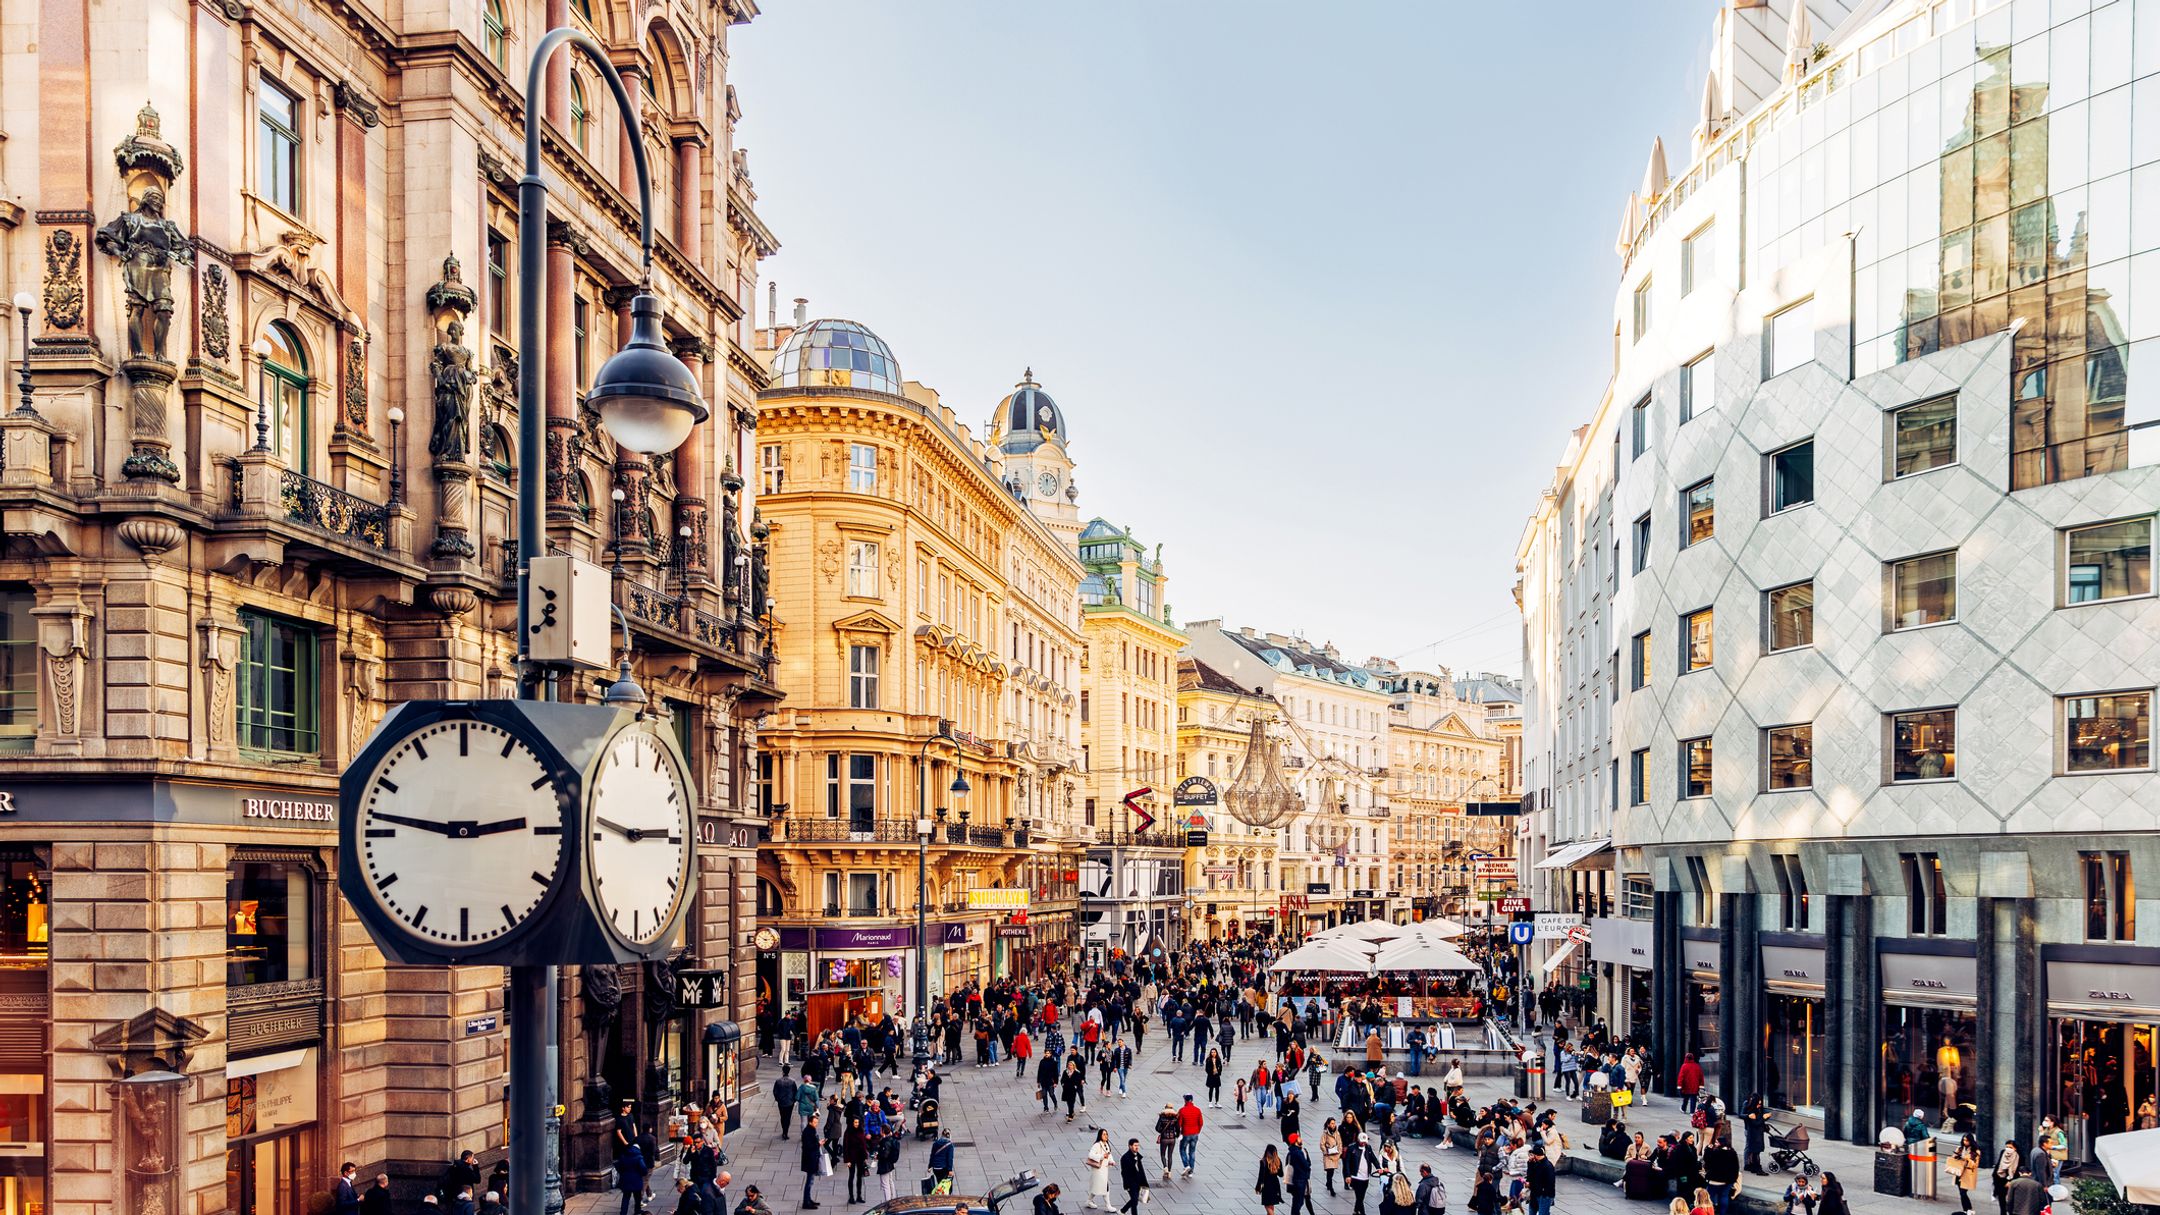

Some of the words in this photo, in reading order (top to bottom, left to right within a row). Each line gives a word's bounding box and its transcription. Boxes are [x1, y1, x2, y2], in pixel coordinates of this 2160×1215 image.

[244, 799, 335, 821] BUCHERER
[973, 890, 1026, 904] STURMAYR
[1504, 898, 1523, 906] FIVE
[851, 932, 892, 942] Marionnaud
[1001, 928, 1026, 936] APOTHEKE
[1515, 927, 1529, 942] U
[1631, 947, 1645, 956] ZARA
[1696, 960, 1714, 969] ZARA
[1783, 969, 1808, 978] ZARA
[1911, 978, 1947, 988] ZARA
[2087, 989, 2134, 1001] ZARA
[249, 1018, 303, 1036] BUCHERER
